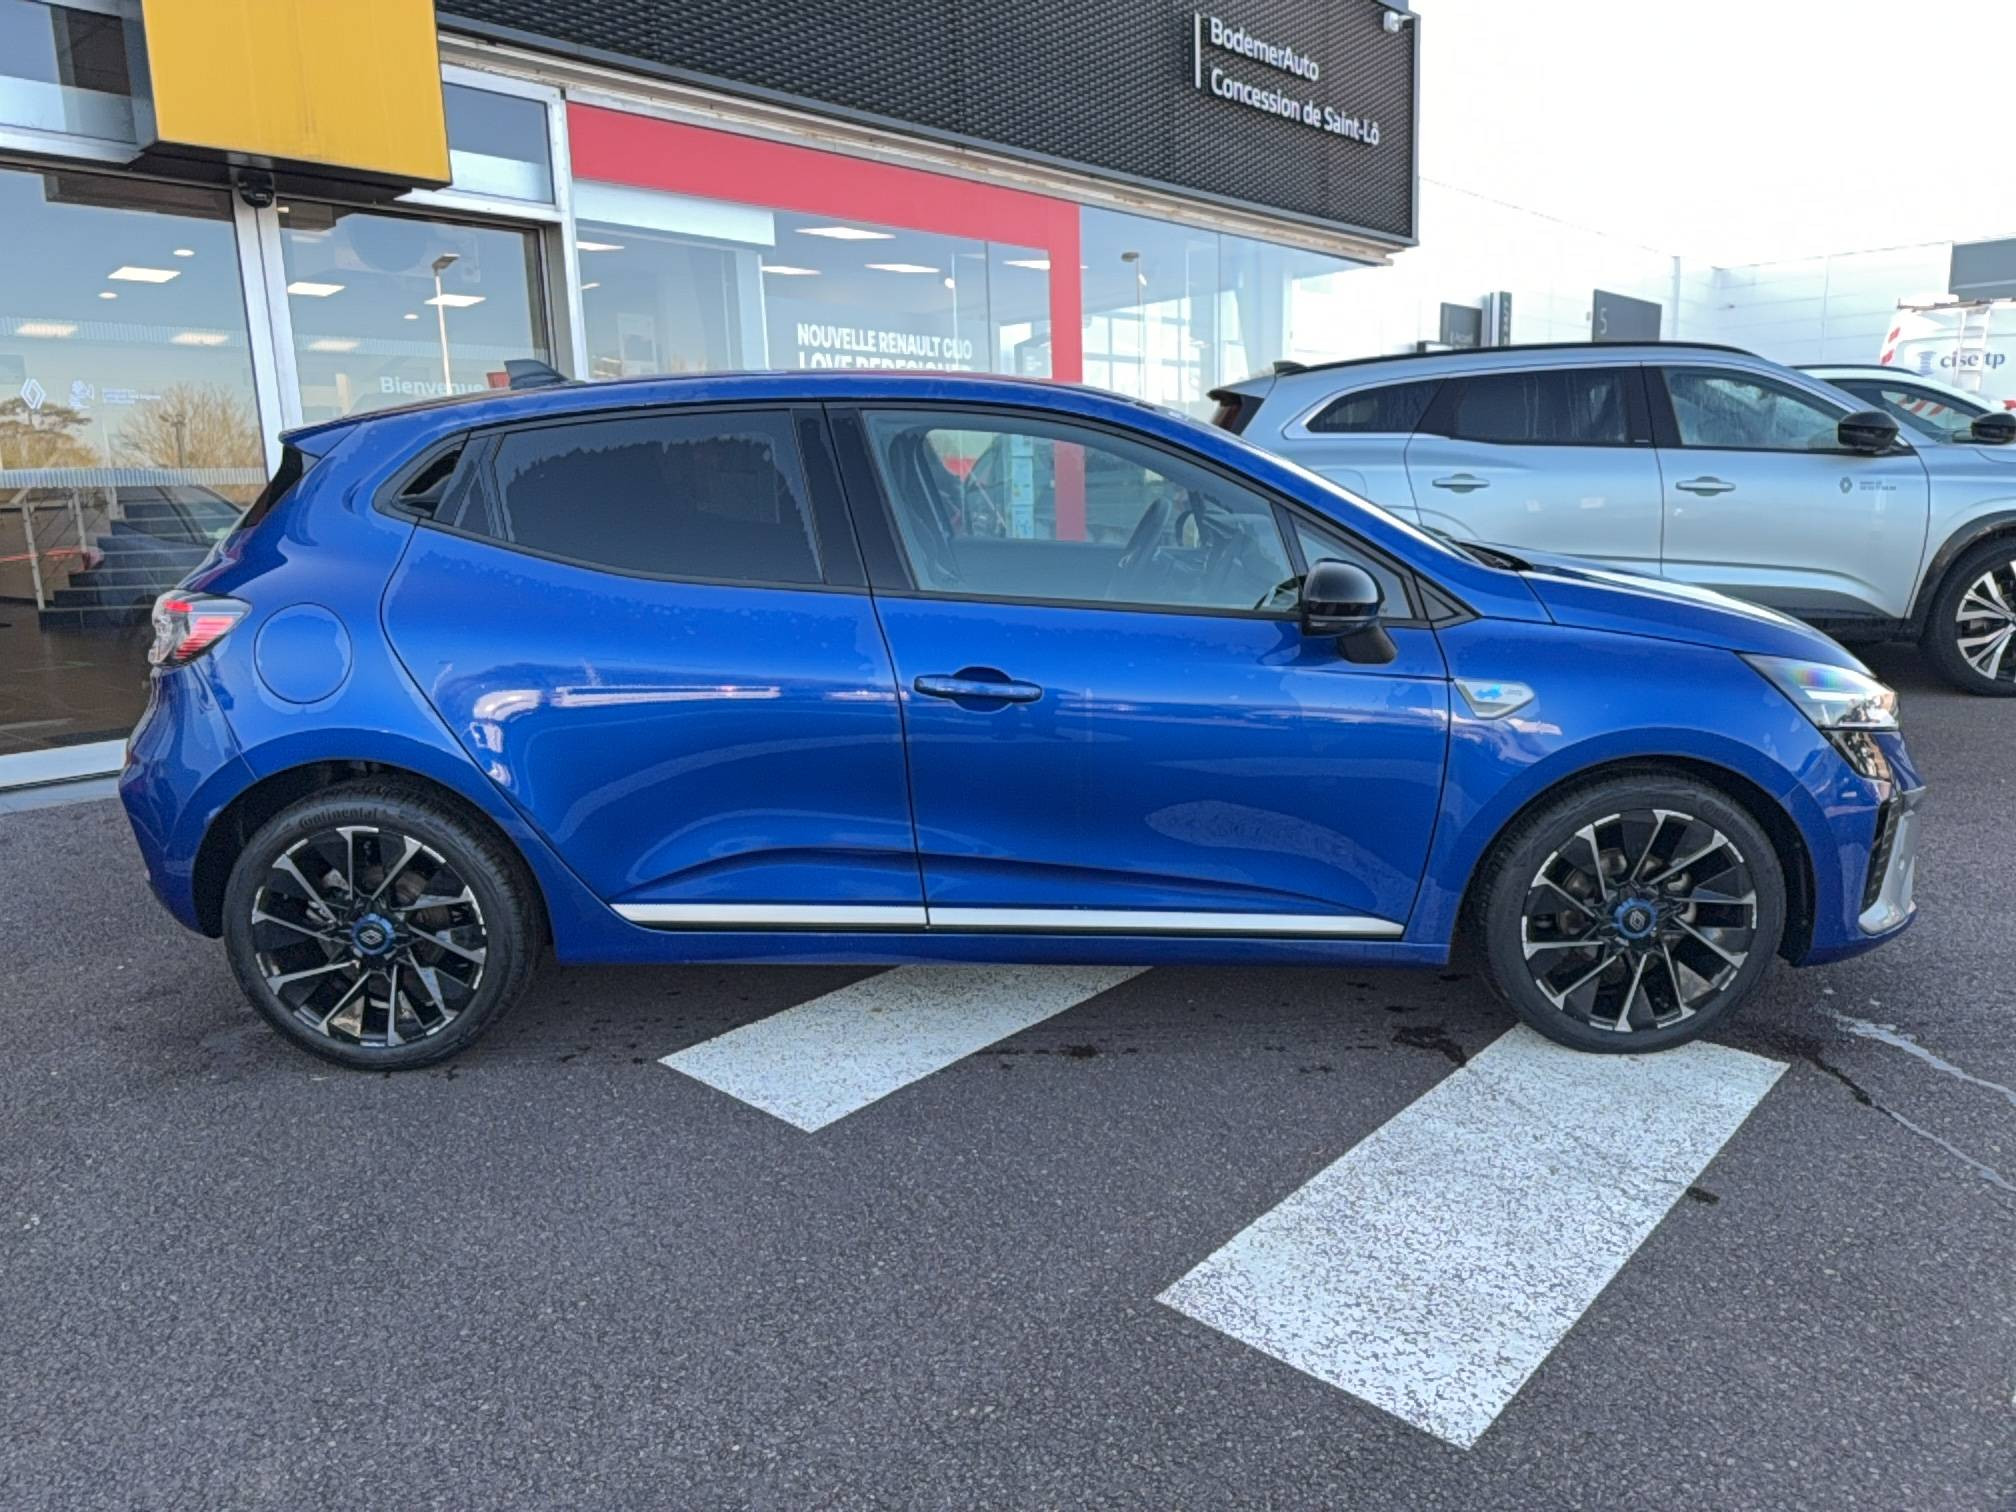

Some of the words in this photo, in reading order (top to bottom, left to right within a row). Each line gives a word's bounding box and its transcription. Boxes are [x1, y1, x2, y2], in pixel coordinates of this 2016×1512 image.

[1210, 16, 1319, 81] BodemerAuto
[1211, 68, 1300, 121] Concession
[1303, 100, 1321, 127] de
[1323, 107, 1380, 145] Saint-Lô
[797, 322, 877, 352] NOUVELLE
[878, 331, 941, 358] RENAULT
[379, 376, 486, 395] Bienvenue
